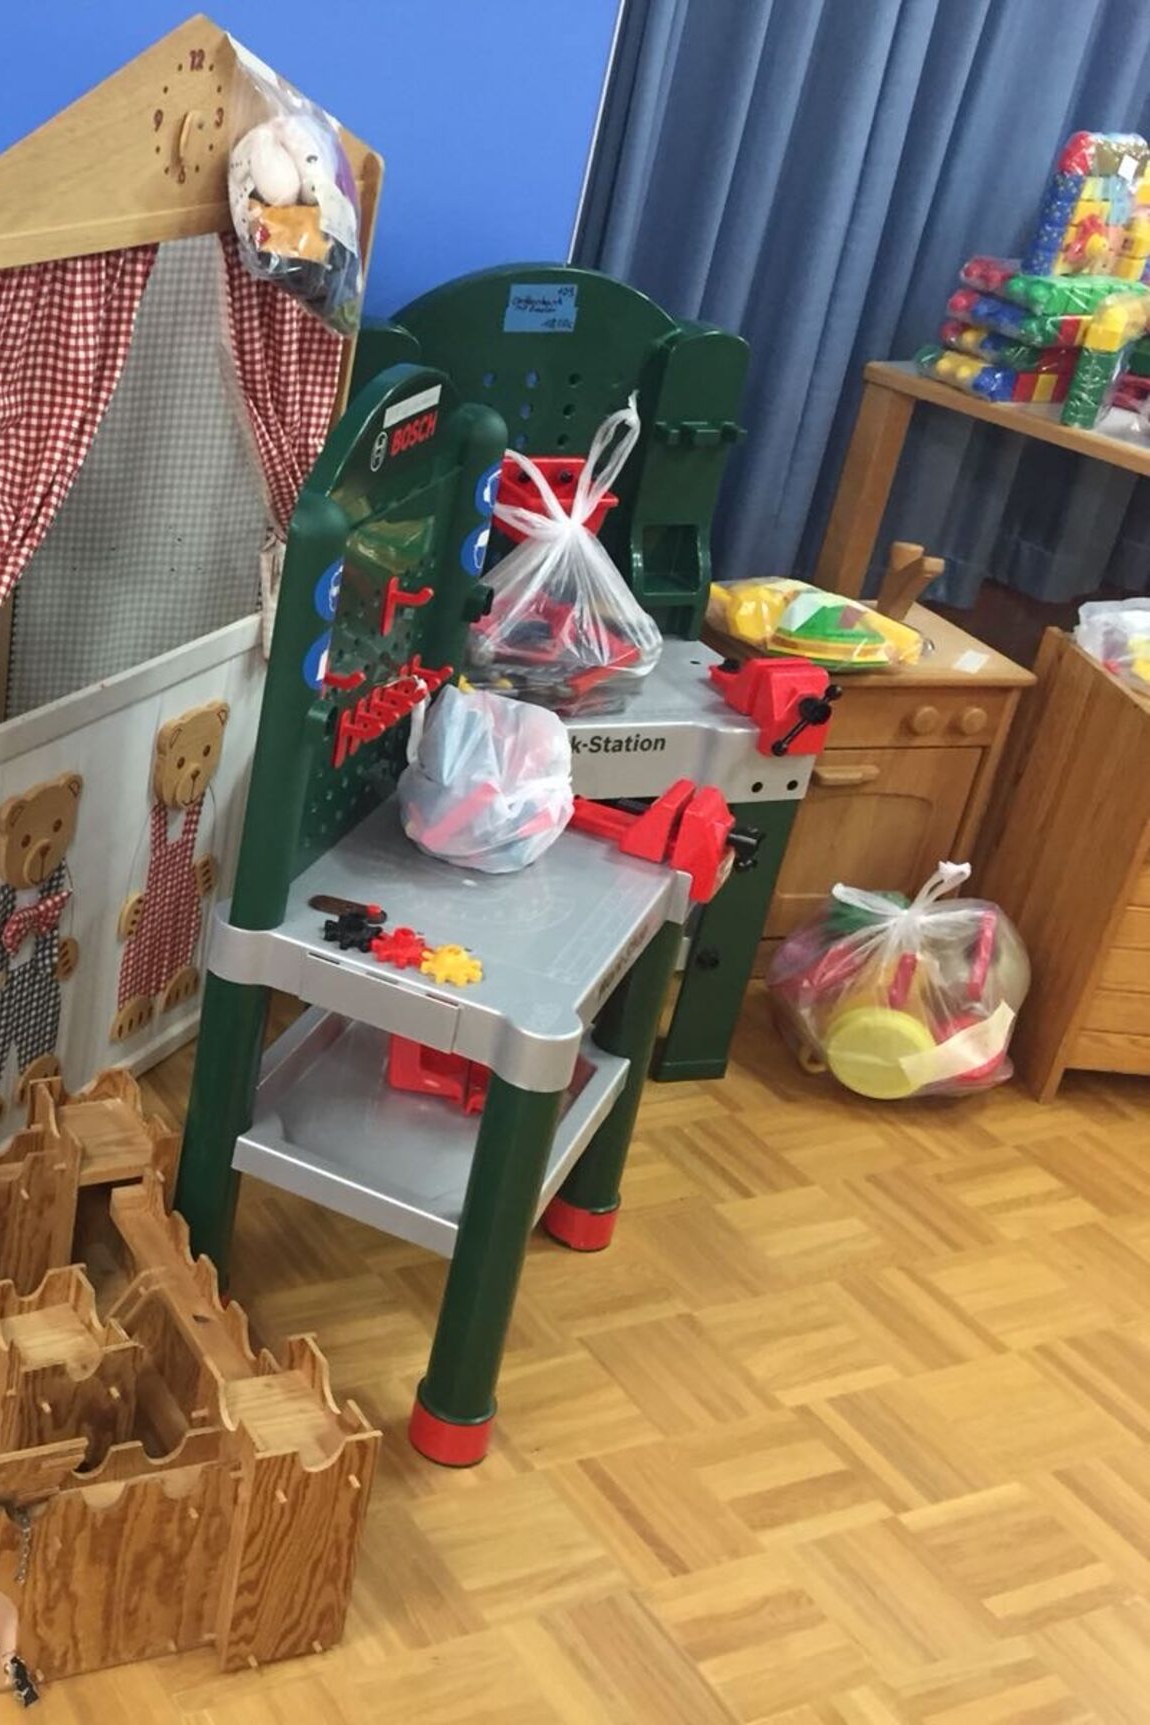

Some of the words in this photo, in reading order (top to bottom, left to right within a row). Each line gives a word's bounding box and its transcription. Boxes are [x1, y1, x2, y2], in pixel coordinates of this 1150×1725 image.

[189, 48, 205, 71] 12
[153, 109, 164, 132] 9
[214, 107, 224, 128] 3
[177, 166, 186, 184] 6
[391, 408, 438, 457] BOSCH
